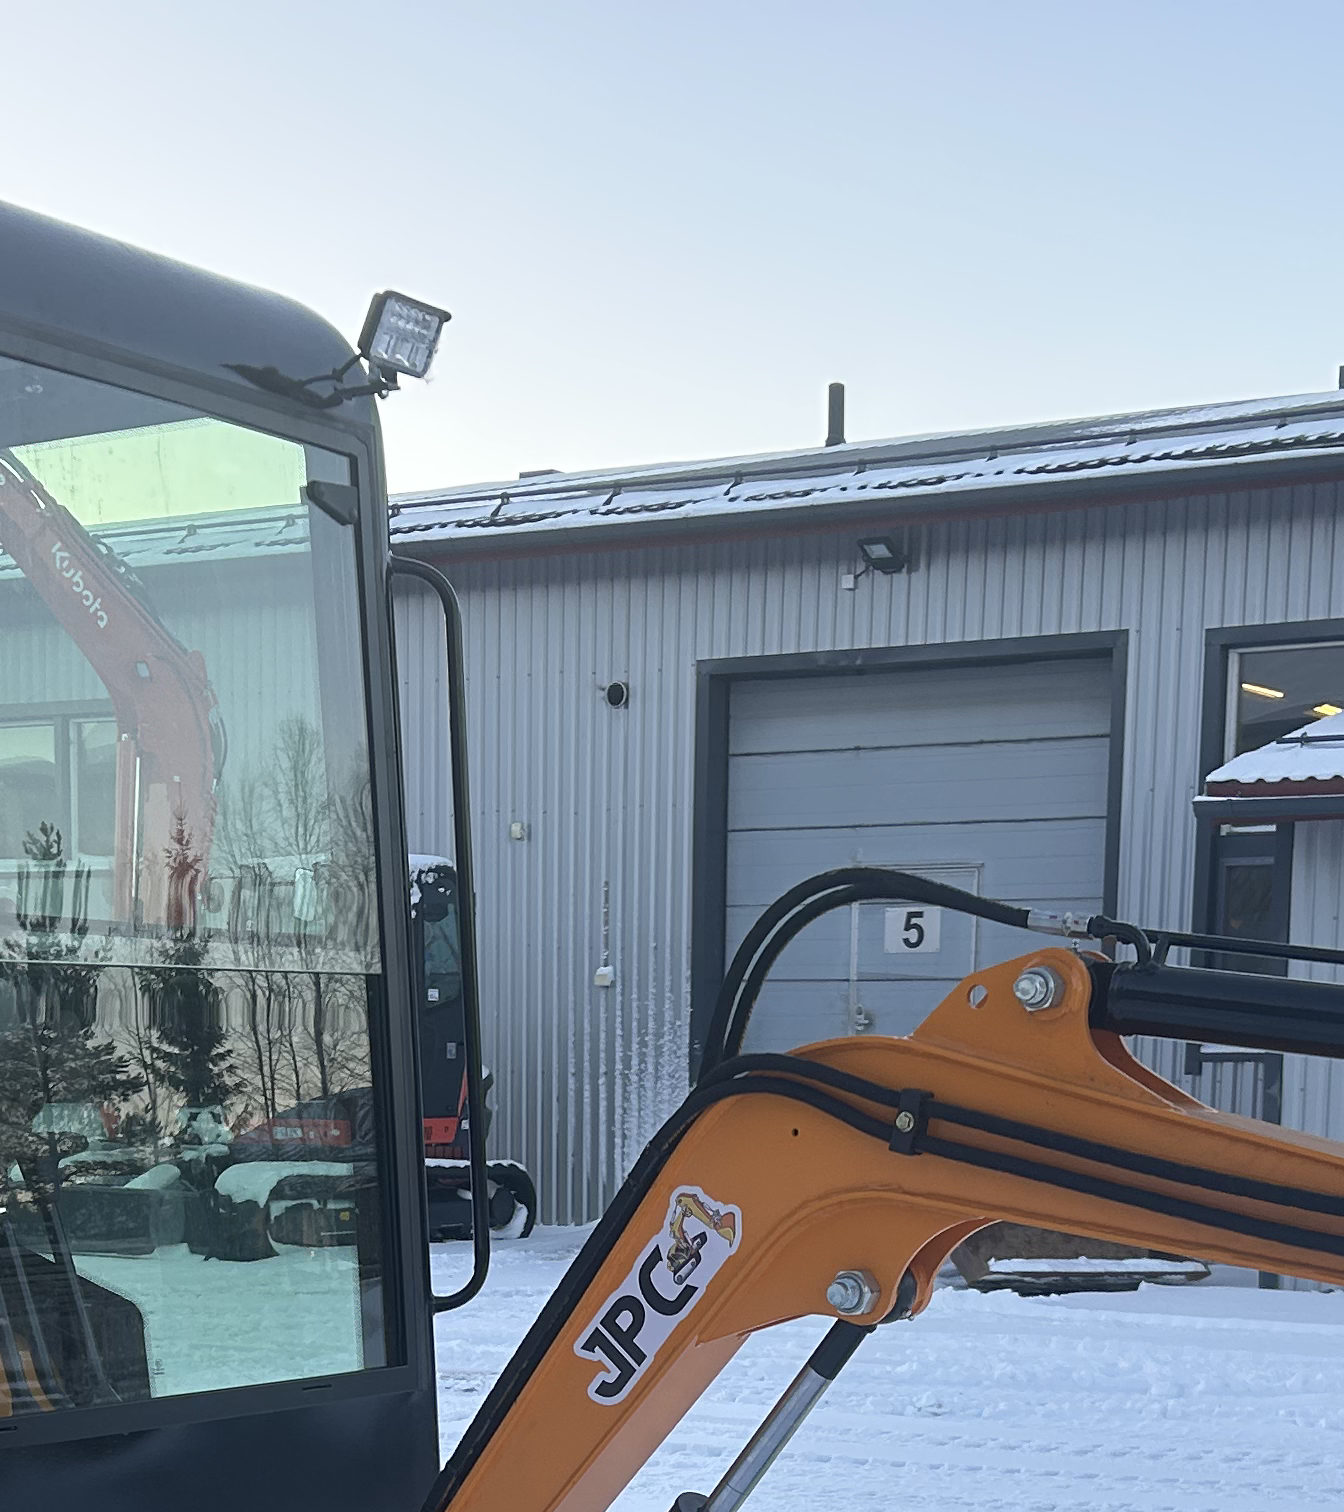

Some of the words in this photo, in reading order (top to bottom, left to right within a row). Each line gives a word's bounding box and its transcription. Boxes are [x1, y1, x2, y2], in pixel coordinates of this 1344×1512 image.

[51, 541, 109, 629] Kubota
[902, 911, 924, 948] 5
[580, 1244, 699, 1398] JPC
